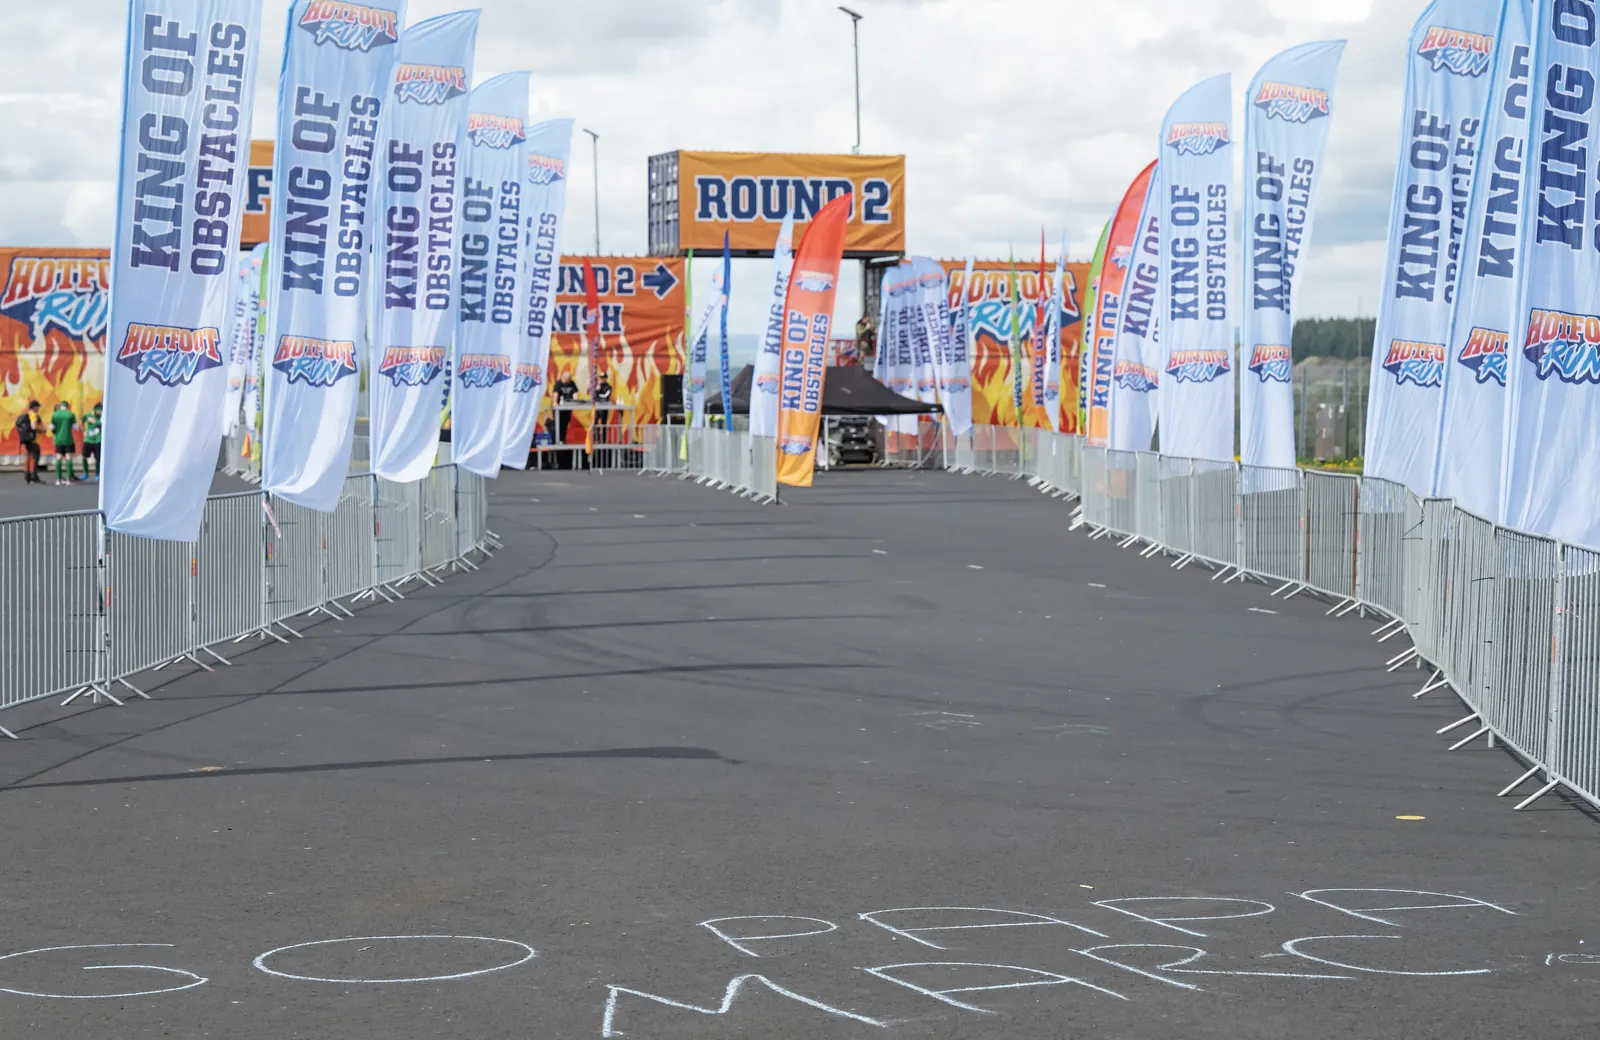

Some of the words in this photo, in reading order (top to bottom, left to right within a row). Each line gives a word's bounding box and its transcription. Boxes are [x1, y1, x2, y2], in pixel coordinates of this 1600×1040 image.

[299, 0, 398, 38] HOTFOOT
[315, 19, 384, 51] RUN
[141, 13, 198, 97] OF
[1432, 48, 1491, 76] RUN
[291, 85, 341, 154] OF
[1254, 82, 1329, 114] HOTFOOT
[190, 21, 247, 276] OBSTACLES
[388, 139, 424, 193] OF
[1410, 109, 1451, 171] OF
[1536, 63, 1596, 250] KING
[130, 112, 188, 273] KING
[333, 94, 382, 298] OBSTACLES
[463, 177, 494, 223] OF
[861, 177, 892, 224] 2
[1170, 184, 1200, 227] OF
[1255, 151, 1285, 202] OF
[1477, 135, 1524, 278] KING
[282, 166, 332, 295] KING
[425, 141, 457, 310] OBSTACLES
[491, 180, 521, 324] OBSTACLES
[1206, 183, 1228, 320] OBSTACLES
[1395, 183, 1444, 302] KING
[385, 205, 421, 310] KING
[460, 234, 490, 323] KING
[527, 212, 557, 338] OBSTACLES
[615, 264, 636, 296] 2
[1170, 237, 1200, 321] KING
[1253, 213, 1284, 310] KING
[763, 303, 784, 356] KING
[786, 309, 809, 344] OF
[1099, 293, 1119, 330] OF
[1122, 263, 1159, 338] KING
[119, 322, 221, 361] HOTFOOT
[138, 350, 201, 384] RUN
[274, 335, 357, 370] HOTFOOT
[288, 357, 340, 387] RUN
[380, 346, 446, 372] HOTFOOT
[803, 312, 829, 414] OBSTACLES
[1166, 350, 1230, 372] HOTFOOT
[394, 363, 435, 387] RUN
[781, 347, 806, 411] KING
[1092, 338, 1114, 409] KING
[1177, 364, 1218, 383] RUN
